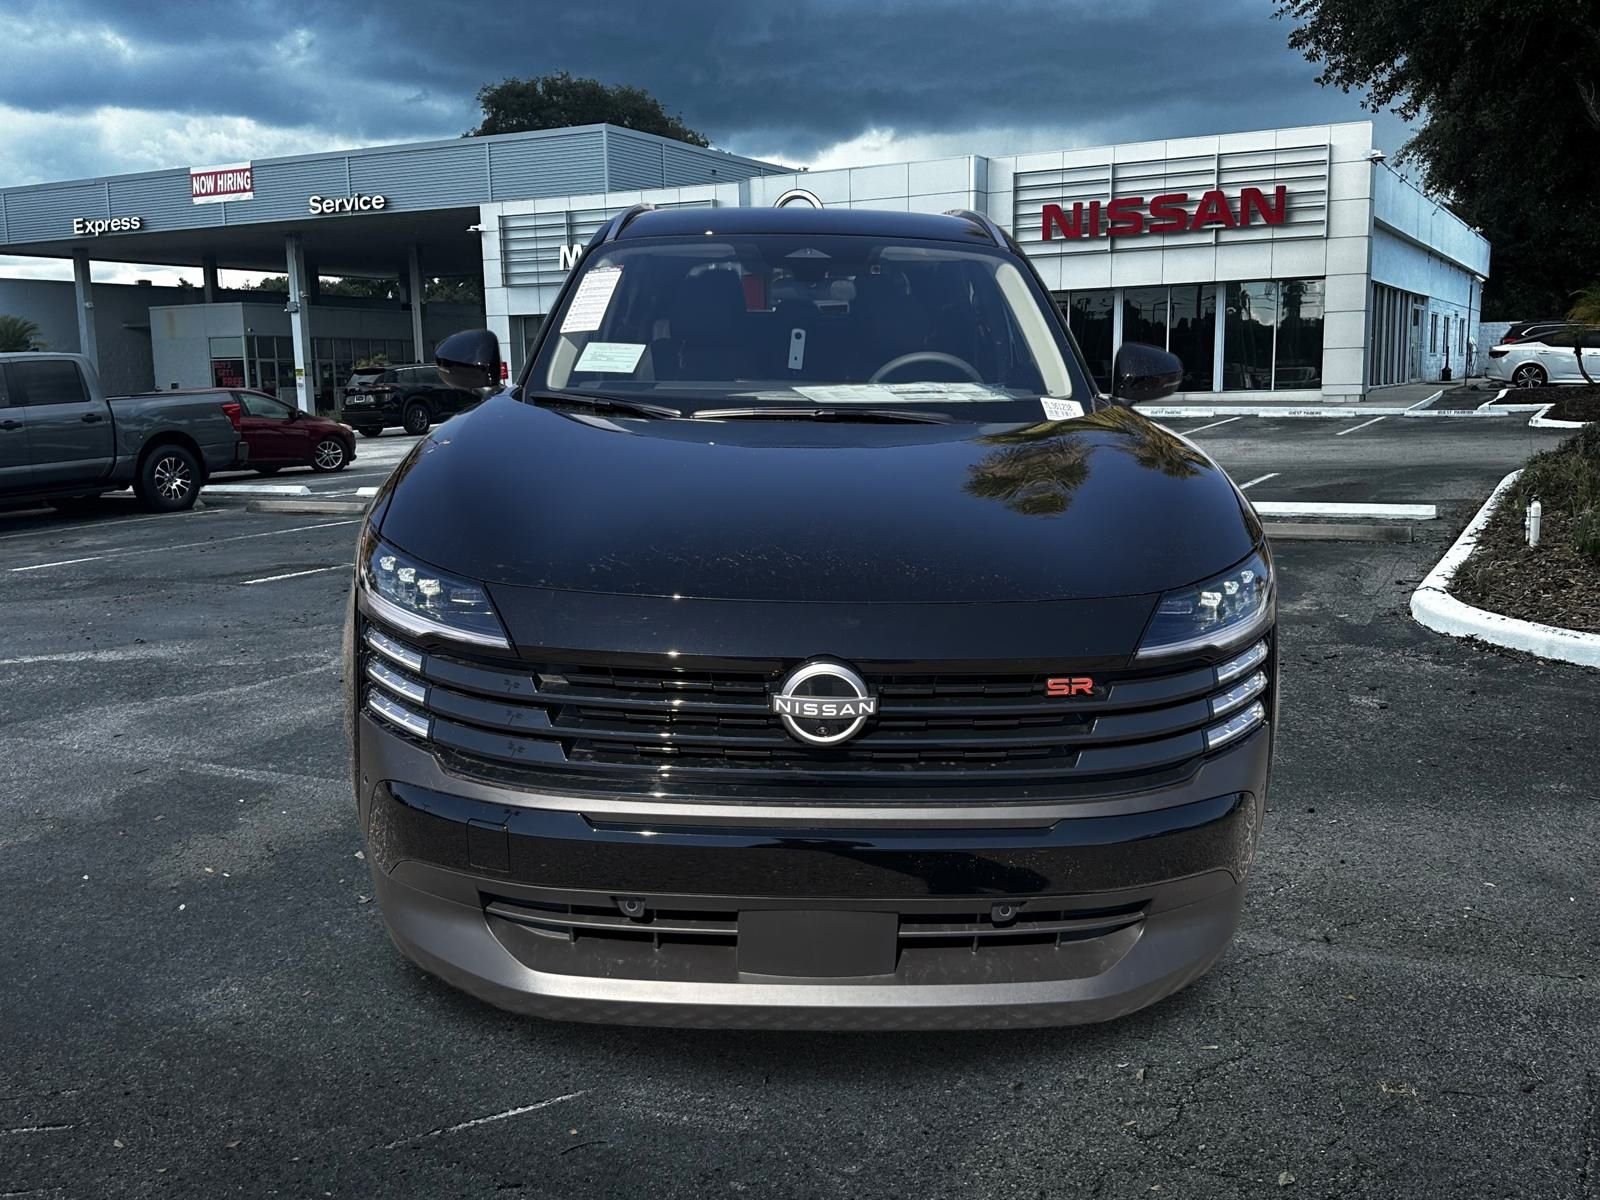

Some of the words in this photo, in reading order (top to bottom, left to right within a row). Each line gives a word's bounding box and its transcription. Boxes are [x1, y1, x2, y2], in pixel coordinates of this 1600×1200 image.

[192, 175, 215, 195] NOW
[217, 171, 251, 192] HIRING
[309, 193, 385, 214] Service
[1042, 185, 1287, 241] NISSAN
[73, 216, 141, 236] Express
[1047, 677, 1094, 696] SR
[775, 698, 874, 716] NISSAN
